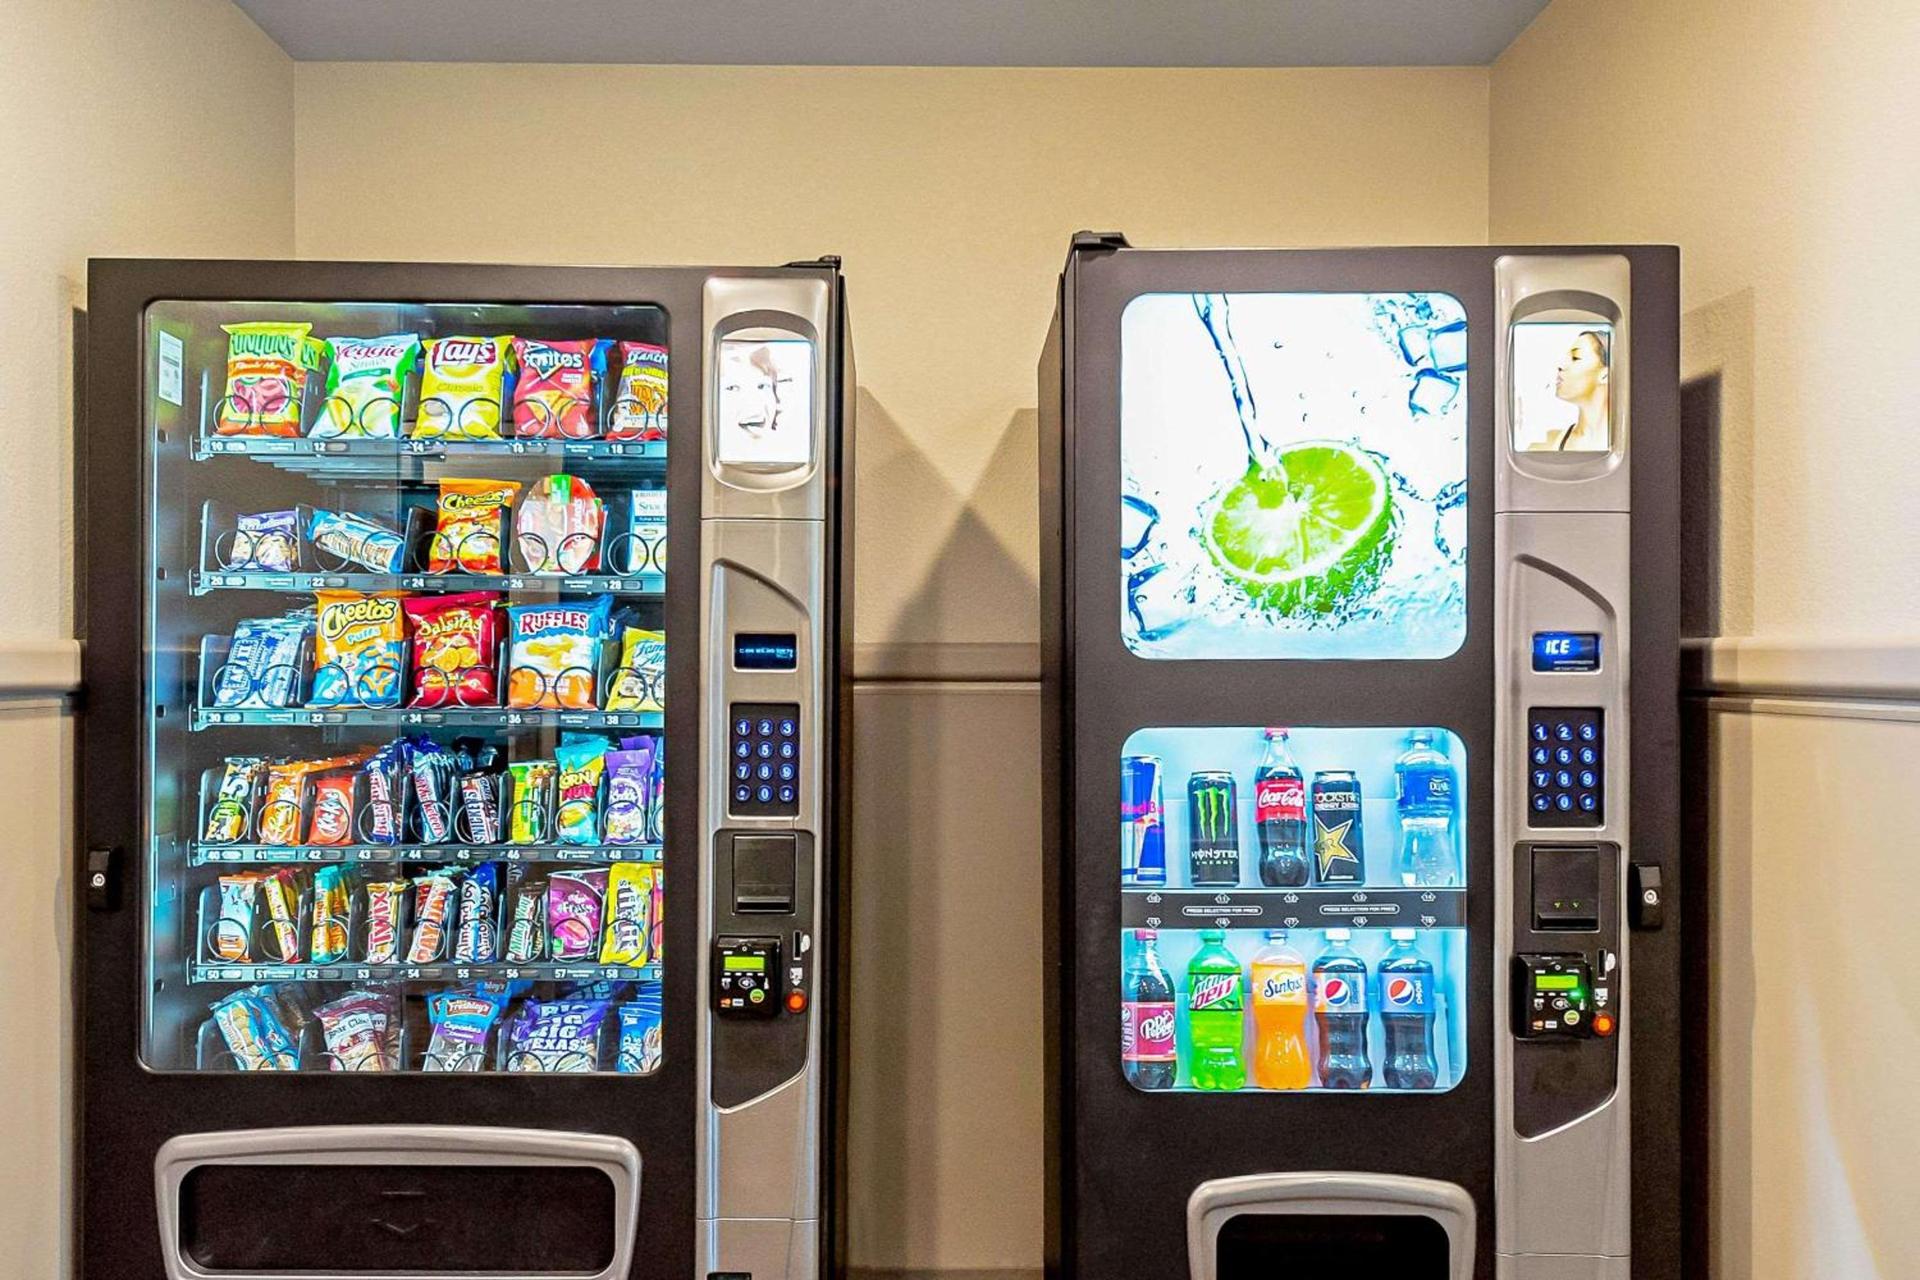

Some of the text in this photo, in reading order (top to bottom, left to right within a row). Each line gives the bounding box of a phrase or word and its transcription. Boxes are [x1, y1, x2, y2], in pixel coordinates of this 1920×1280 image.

[336, 344, 404, 362] Veggie
[435, 341, 496, 365] Lay's
[322, 599, 397, 639] Cheetos
[520, 611, 588, 633] RUFFLES
[347, 627, 382, 644] Puffs
[1545, 639, 1570, 655] ICE
[463, 788, 483, 842] SNICKERS
[1191, 848, 1239, 860] MONSTER
[456, 881, 476, 960] Almond Joy
[509, 920, 527, 956] Milky
[1264, 977, 1302, 998] Sunkis
[523, 1038, 579, 1051] TEXAS
